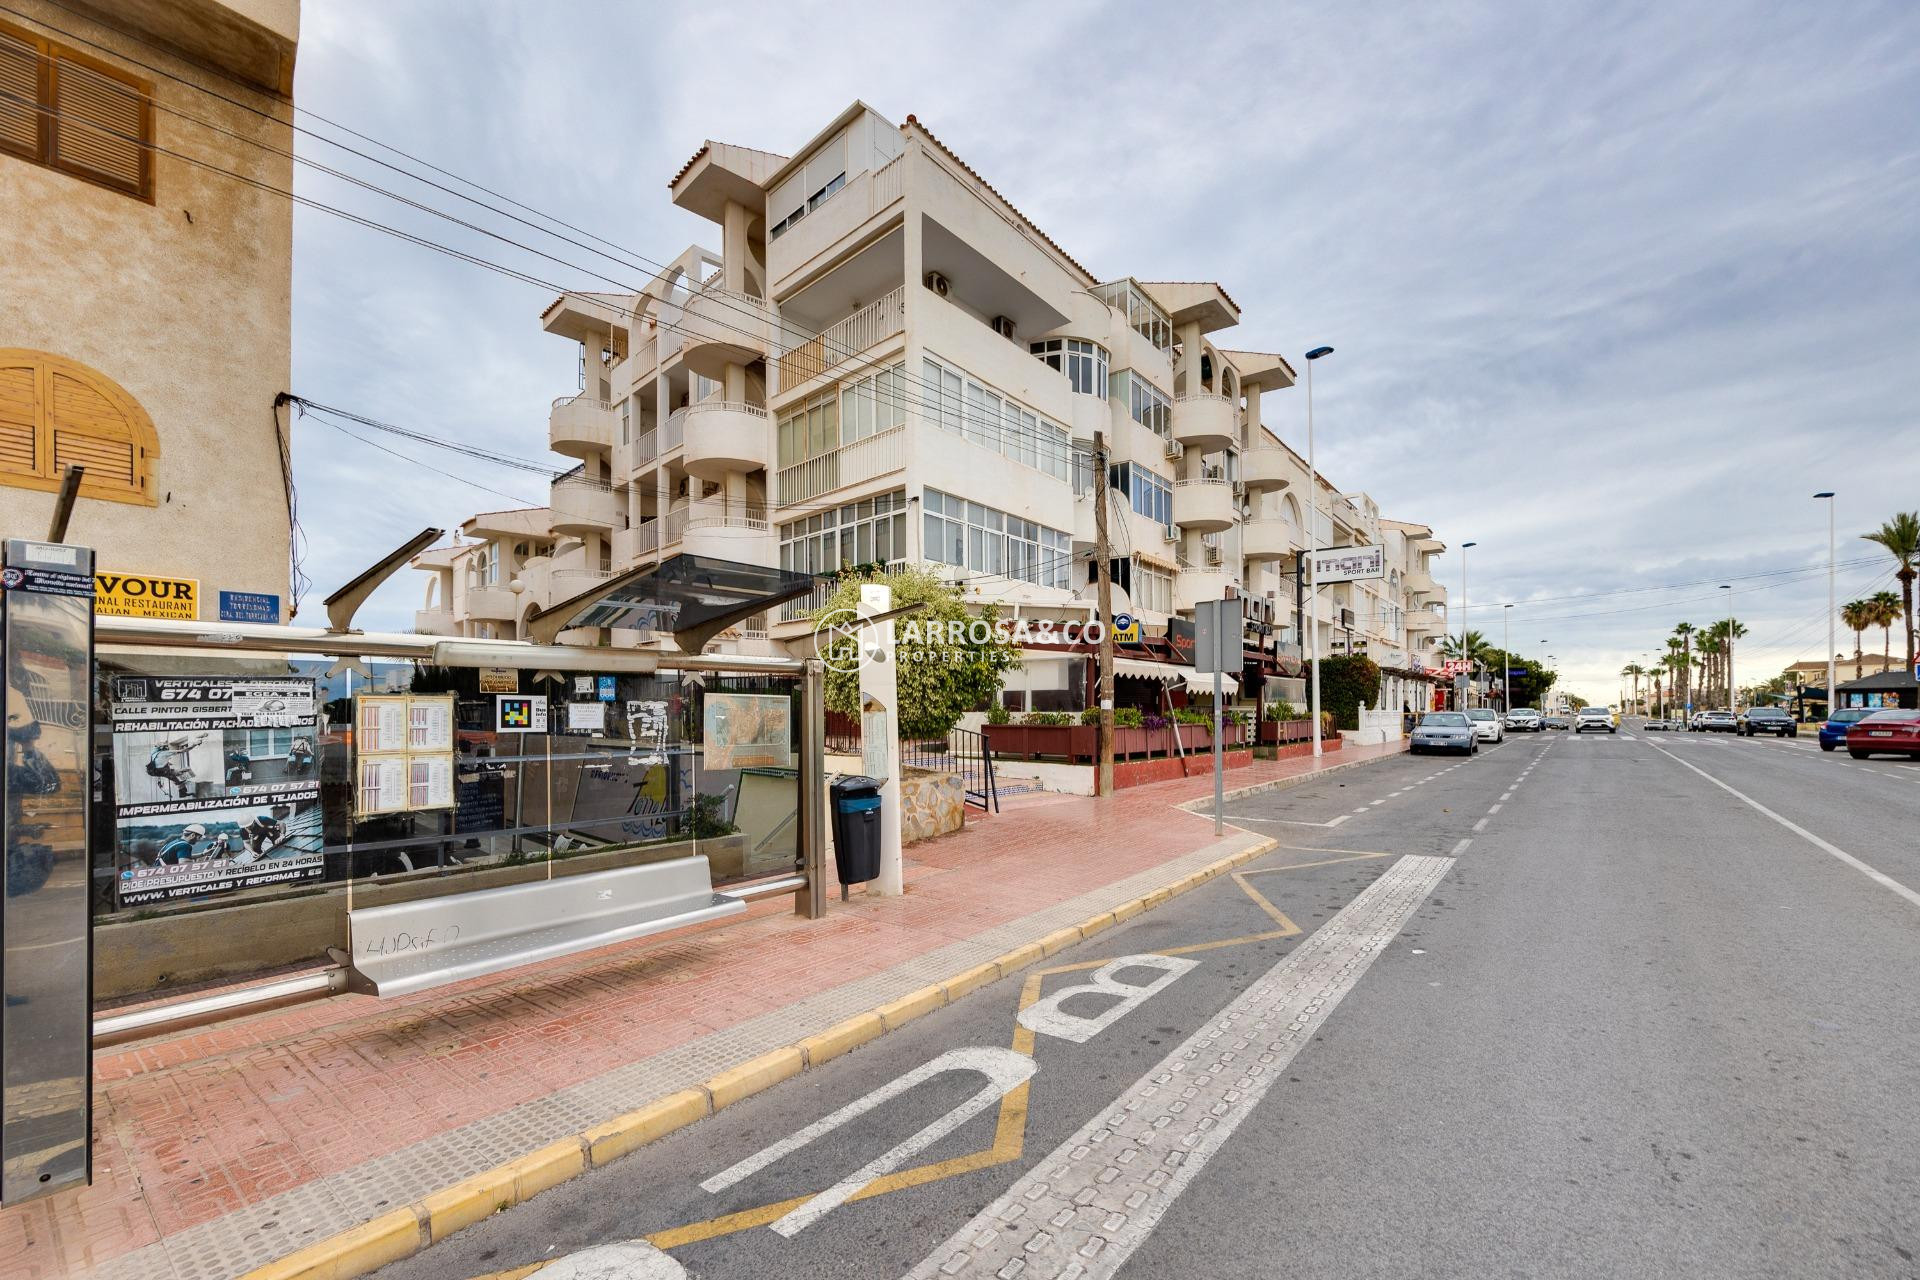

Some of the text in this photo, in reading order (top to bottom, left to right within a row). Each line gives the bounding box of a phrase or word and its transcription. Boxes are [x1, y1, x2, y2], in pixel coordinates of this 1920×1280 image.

[1344, 568, 1365, 576] SPORT
[95, 576, 193, 600] VOUR
[95, 596, 193, 611] NAL RESTAURANT
[96, 607, 192, 619] ALIAN MEXICAN
[1113, 633, 1134, 642] ATM
[1176, 634, 1195, 650] Spor
[1447, 661, 1471, 672] 24H
[154, 680, 232, 688] VERTICALES
[161, 688, 201, 700] 674
[208, 688, 232, 699] 07
[114, 707, 147, 715] CALLE
[151, 706, 189, 714] PINTOR
[115, 718, 209, 732] REHABILITACIÓN
[212, 719, 254, 730] FACHAD
[243, 781, 319, 794] 674 07 57 21
[119, 791, 318, 817] IMPERMEABILIZACIÓN DE TEJADOS
[121, 855, 323, 891] PIDE PRESUPUESTO Y RECÍBELO EN 24 HORAS
[137, 859, 228, 878] 674 07 57 21
[123, 891, 165, 904] WWW.
[168, 881, 233, 897] VERTICALES
[236, 878, 244, 887] Y
[308, 867, 323, 876] ES
